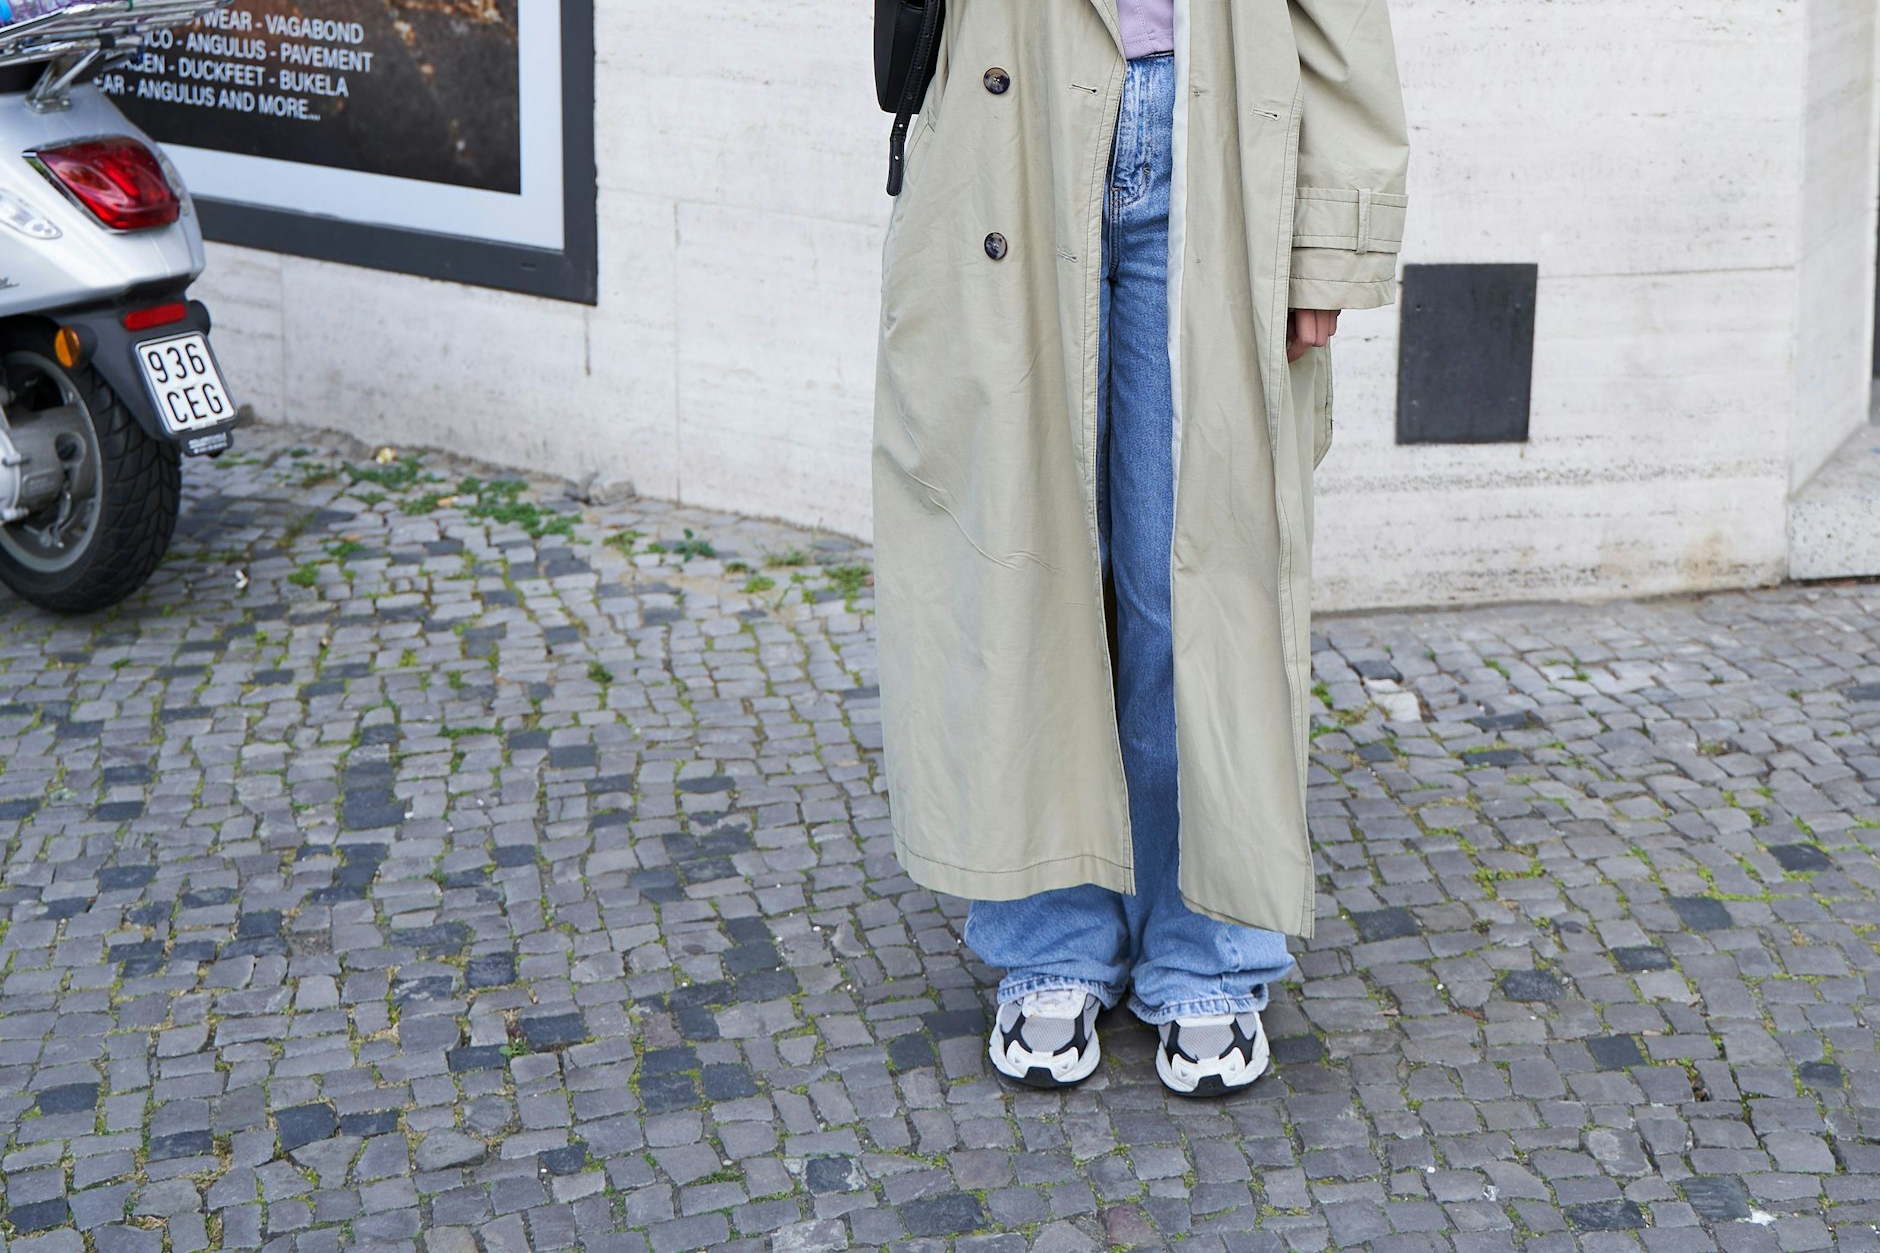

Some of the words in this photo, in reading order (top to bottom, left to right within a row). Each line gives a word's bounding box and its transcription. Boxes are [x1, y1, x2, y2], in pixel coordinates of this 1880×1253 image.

[265, 13, 364, 44] VAGABOND
[185, 33, 267, 61] ANGULUS
[280, 42, 374, 73] PAVEMENT
[178, 57, 266, 87] DUCKFEET
[279, 69, 350, 98] BUKELA
[137, 78, 216, 107] ANGULUS
[217, 89, 256, 112] AND
[258, 95, 321, 121] MORE...
[148, 343, 206, 383] 936
[167, 383, 223, 423] CEG
